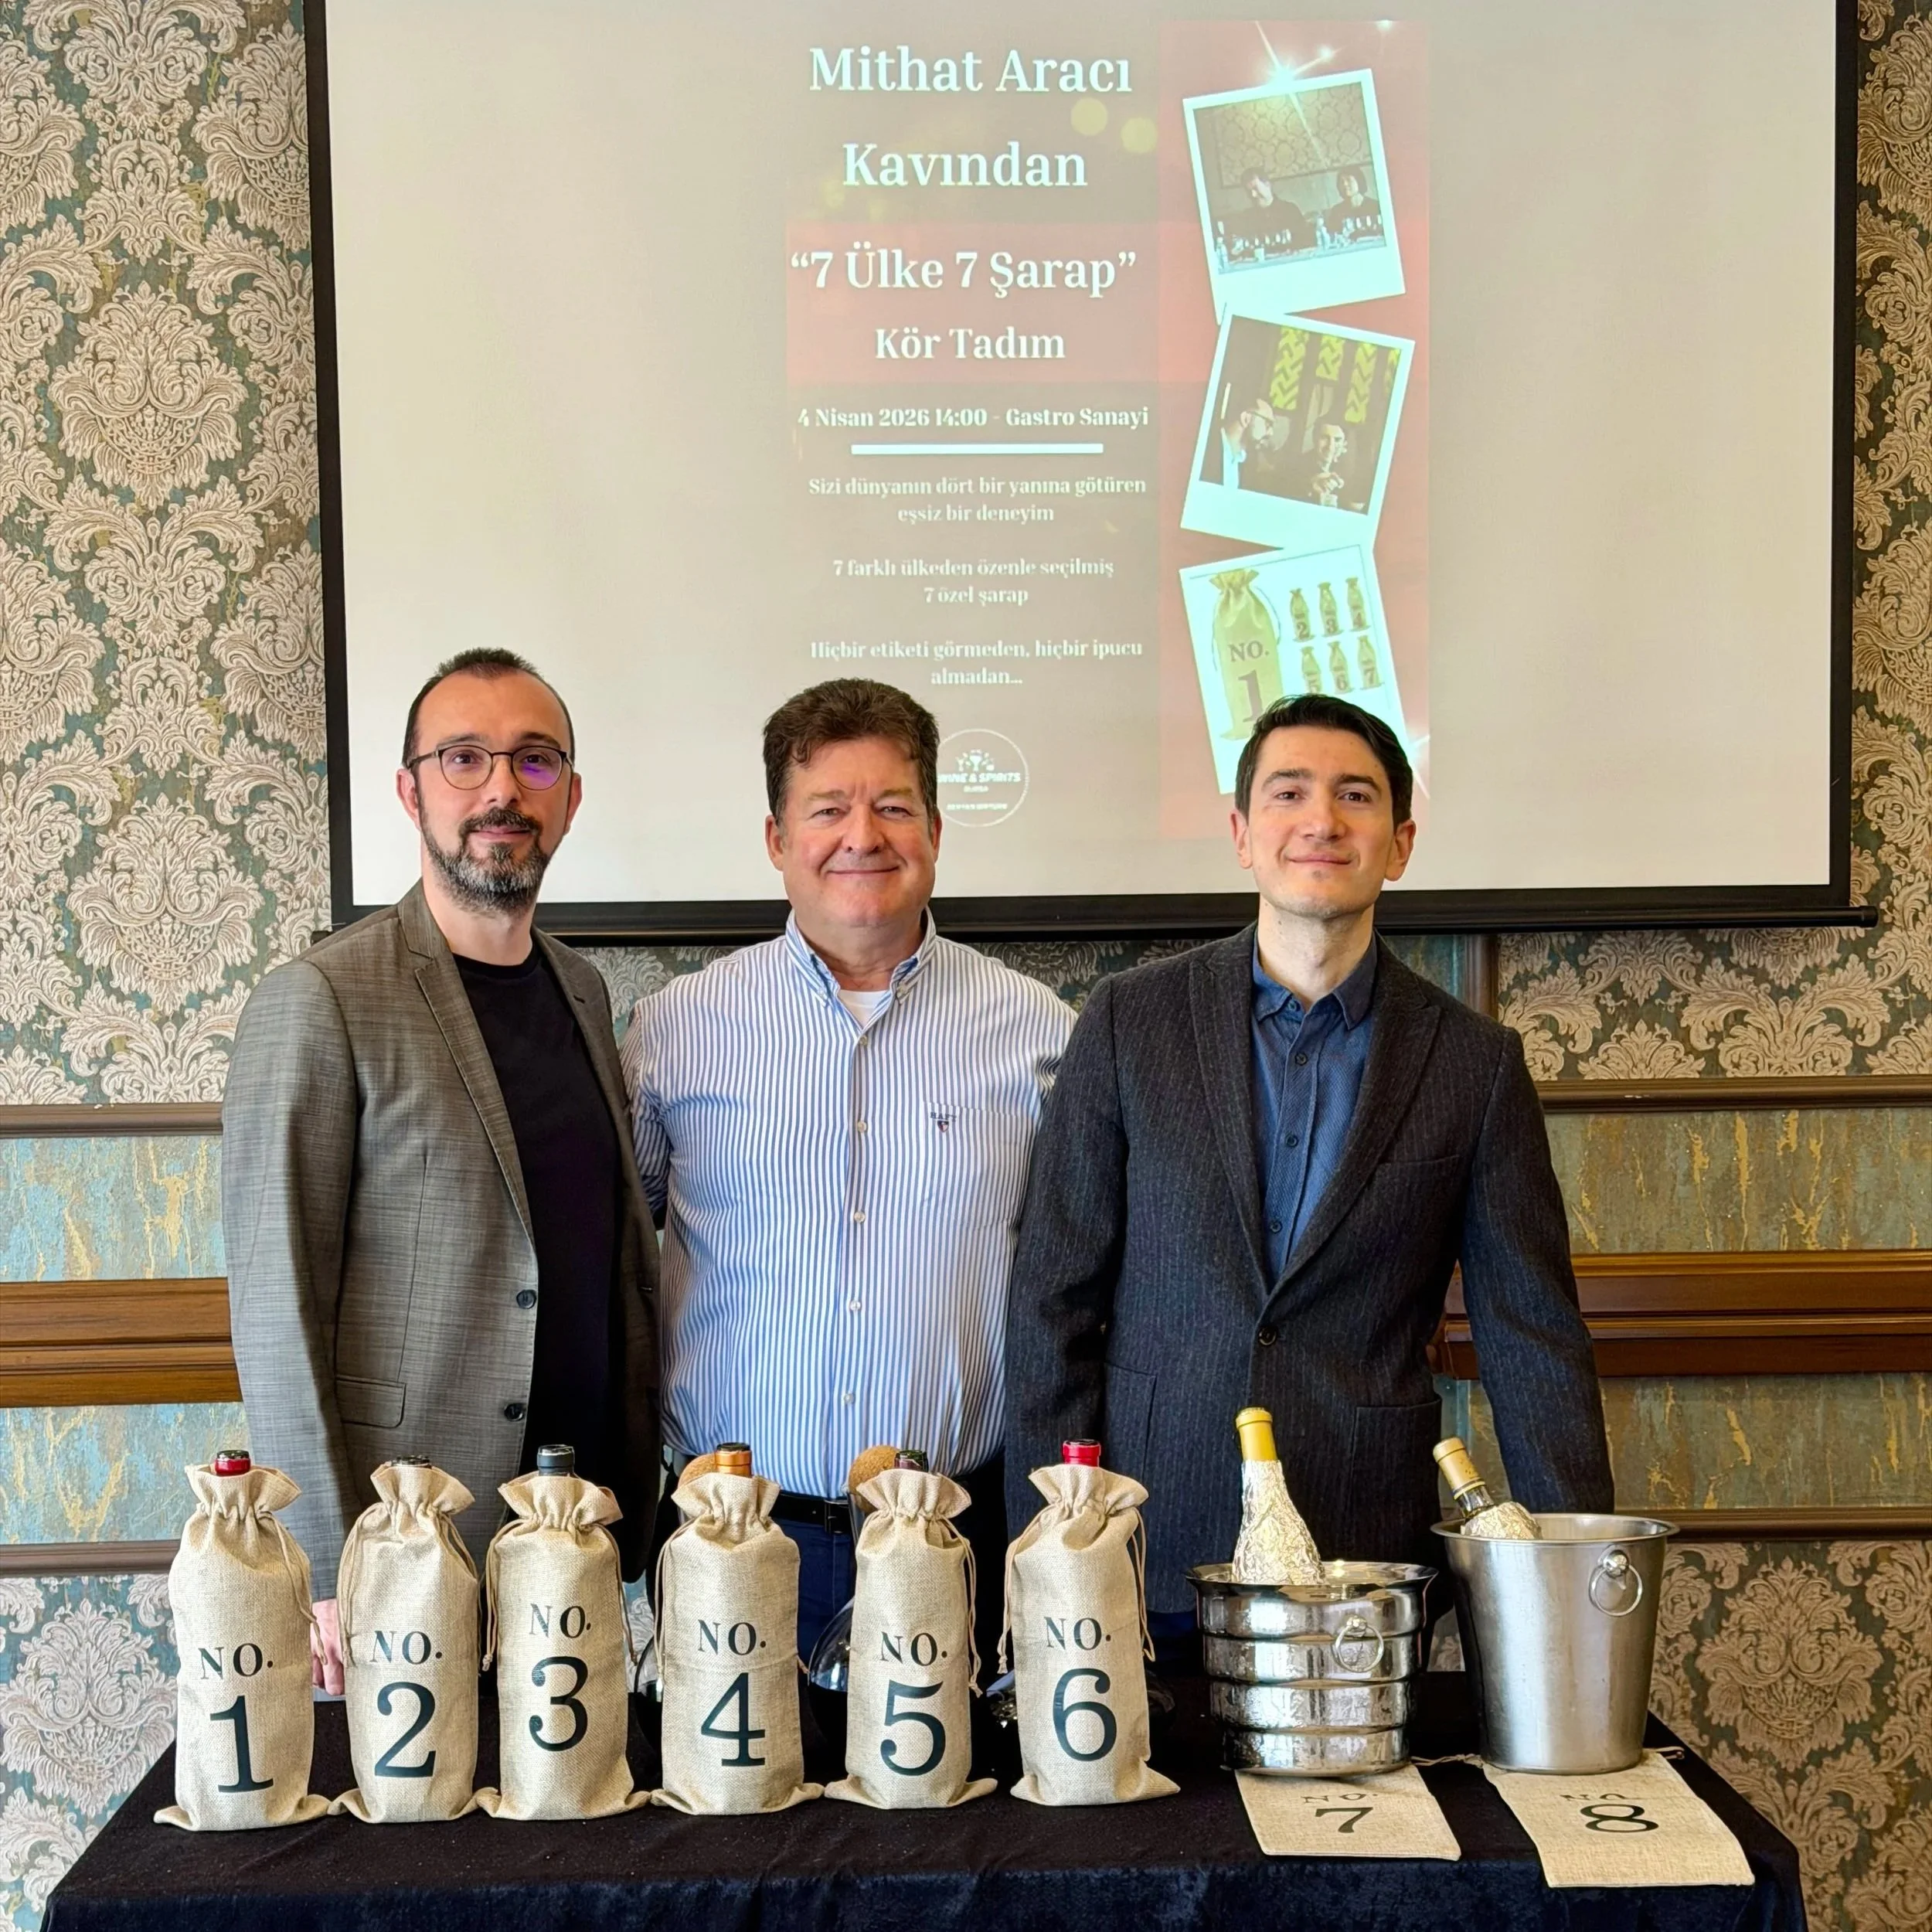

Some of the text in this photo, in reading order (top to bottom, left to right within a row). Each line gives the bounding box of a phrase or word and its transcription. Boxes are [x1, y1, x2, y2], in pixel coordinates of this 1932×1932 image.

[809, 45, 1132, 93] Mithat Aracı
[842, 141, 1088, 187] Kavından
[845, 240, 944, 288] Ülke
[956, 251, 978, 287] 7
[876, 325, 1066, 359] Kör Tadım
[798, 408, 809, 427] 4
[815, 407, 873, 427] Nisan
[879, 408, 930, 427] 2026
[935, 408, 988, 427] 14:00
[1005, 408, 1075, 426] Gastro
[1080, 406, 1148, 430] Sanayi
[808, 476, 1146, 499] Sizi dünyanın dört bir yanına götüren
[898, 503, 1054, 526] eşsiz bir deneyim
[833, 560, 843, 577] 7
[901, 559, 973, 576] ülkeden
[977, 558, 1036, 576] özenle
[1039, 557, 1114, 579] seçilmiş
[923, 585, 1029, 607] 7 özel şarap
[1297, 621, 1310, 640] 2
[811, 641, 866, 662] Hiçbir
[869, 640, 929, 658] etiketi
[1035, 639, 1089, 660] hiçbir
[1093, 638, 1142, 660] ipucu
[1228, 641, 1270, 662] NO.
[1363, 667, 1375, 685] 7
[1238, 669, 1264, 723] 1
[529, 1603, 592, 1639] NO.
[699, 1620, 767, 1656] NO.
[1046, 1617, 1112, 1651] NO.
[198, 1642, 274, 1680] NO.
[371, 1630, 442, 1665] NO.
[882, 1631, 948, 1667] NO.
[529, 1655, 589, 1752] 3
[701, 1672, 767, 1767] 4
[1053, 1668, 1117, 1762] 6
[210, 1695, 274, 1793] 1
[375, 1682, 440, 1779] 2
[880, 1680, 950, 1777] 5
[1315, 1807, 1373, 1833] 7
[1580, 1803, 1659, 1833] 8
